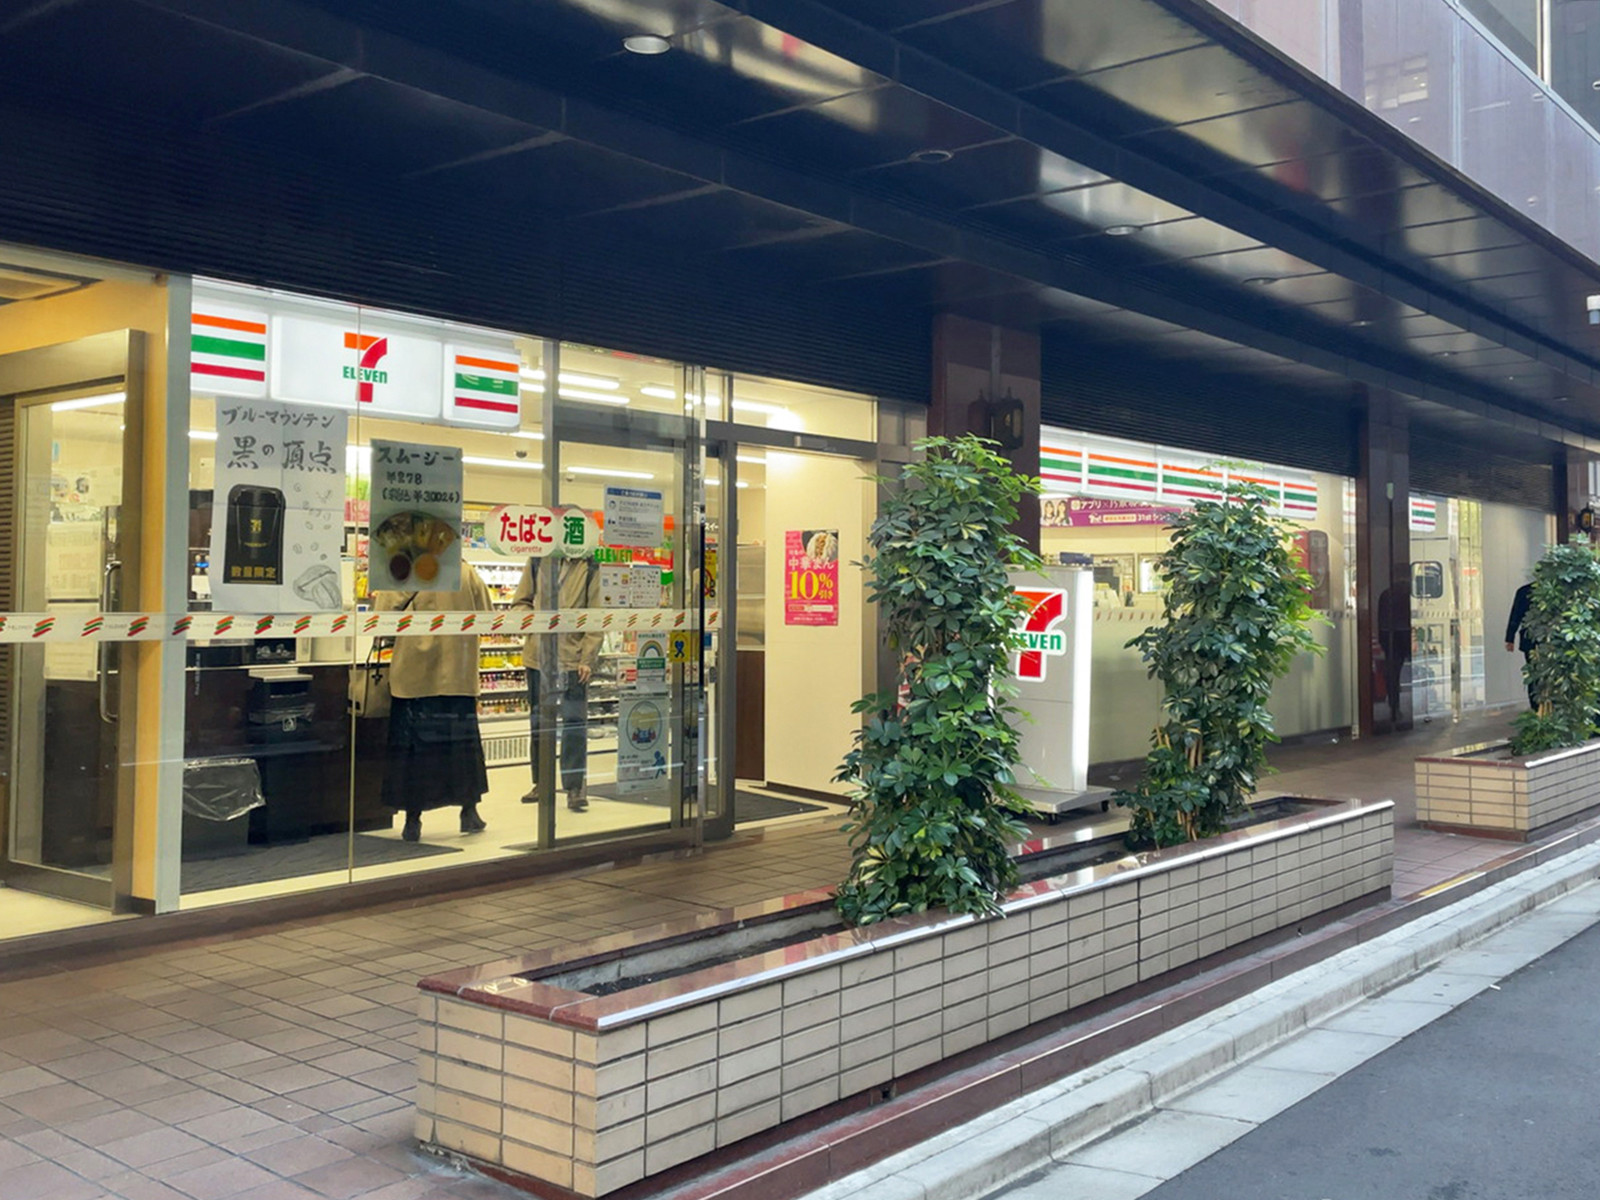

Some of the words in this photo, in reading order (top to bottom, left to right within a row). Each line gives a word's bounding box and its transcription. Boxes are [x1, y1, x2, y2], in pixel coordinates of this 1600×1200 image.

[344, 331, 387, 403] 7
[222, 406, 335, 428] ブルーマウンテン
[227, 435, 337, 474] 黒の頂点
[377, 446, 455, 466] スムージー
[386, 470, 422, 485] ¥278
[500, 512, 553, 543] たばこ
[563, 516, 585, 545] 酒
[788, 556, 834, 570] 中華まん
